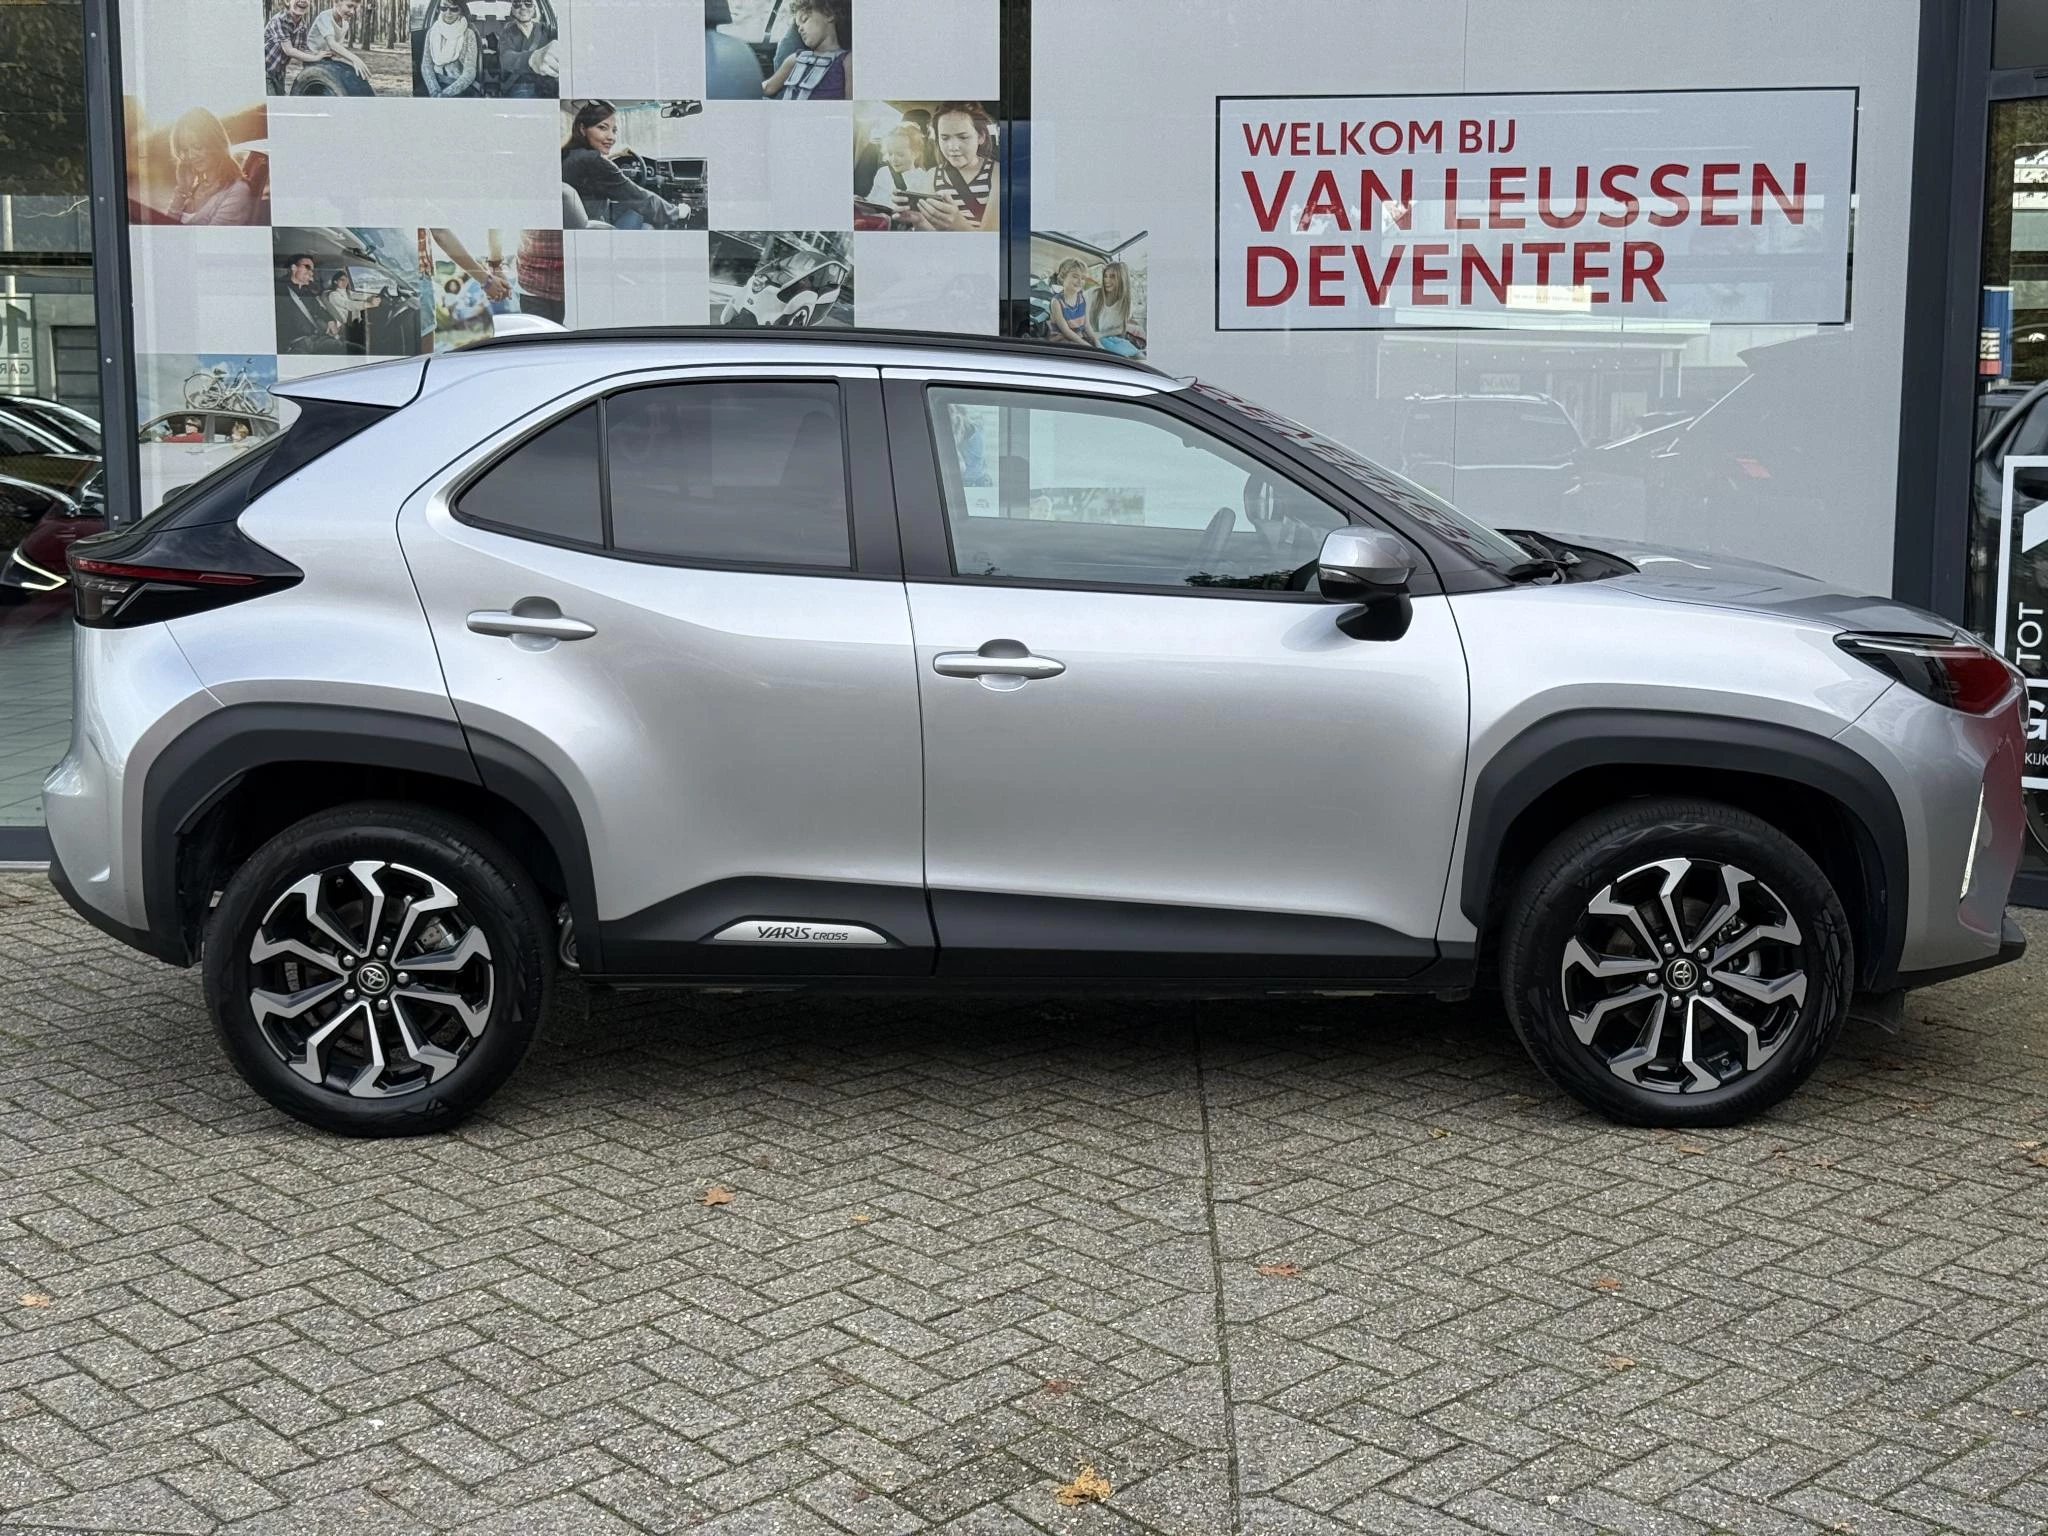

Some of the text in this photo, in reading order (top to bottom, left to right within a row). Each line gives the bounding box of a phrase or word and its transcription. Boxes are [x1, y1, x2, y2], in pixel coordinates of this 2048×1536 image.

[1242, 119, 1516, 156] WELKOM BIJ
[1241, 162, 1807, 232] VAN LEUSSEN
[1246, 241, 1668, 307] DEVENTER
[2015, 601, 2044, 666] TOT
[812, 931, 848, 941] CROSS
